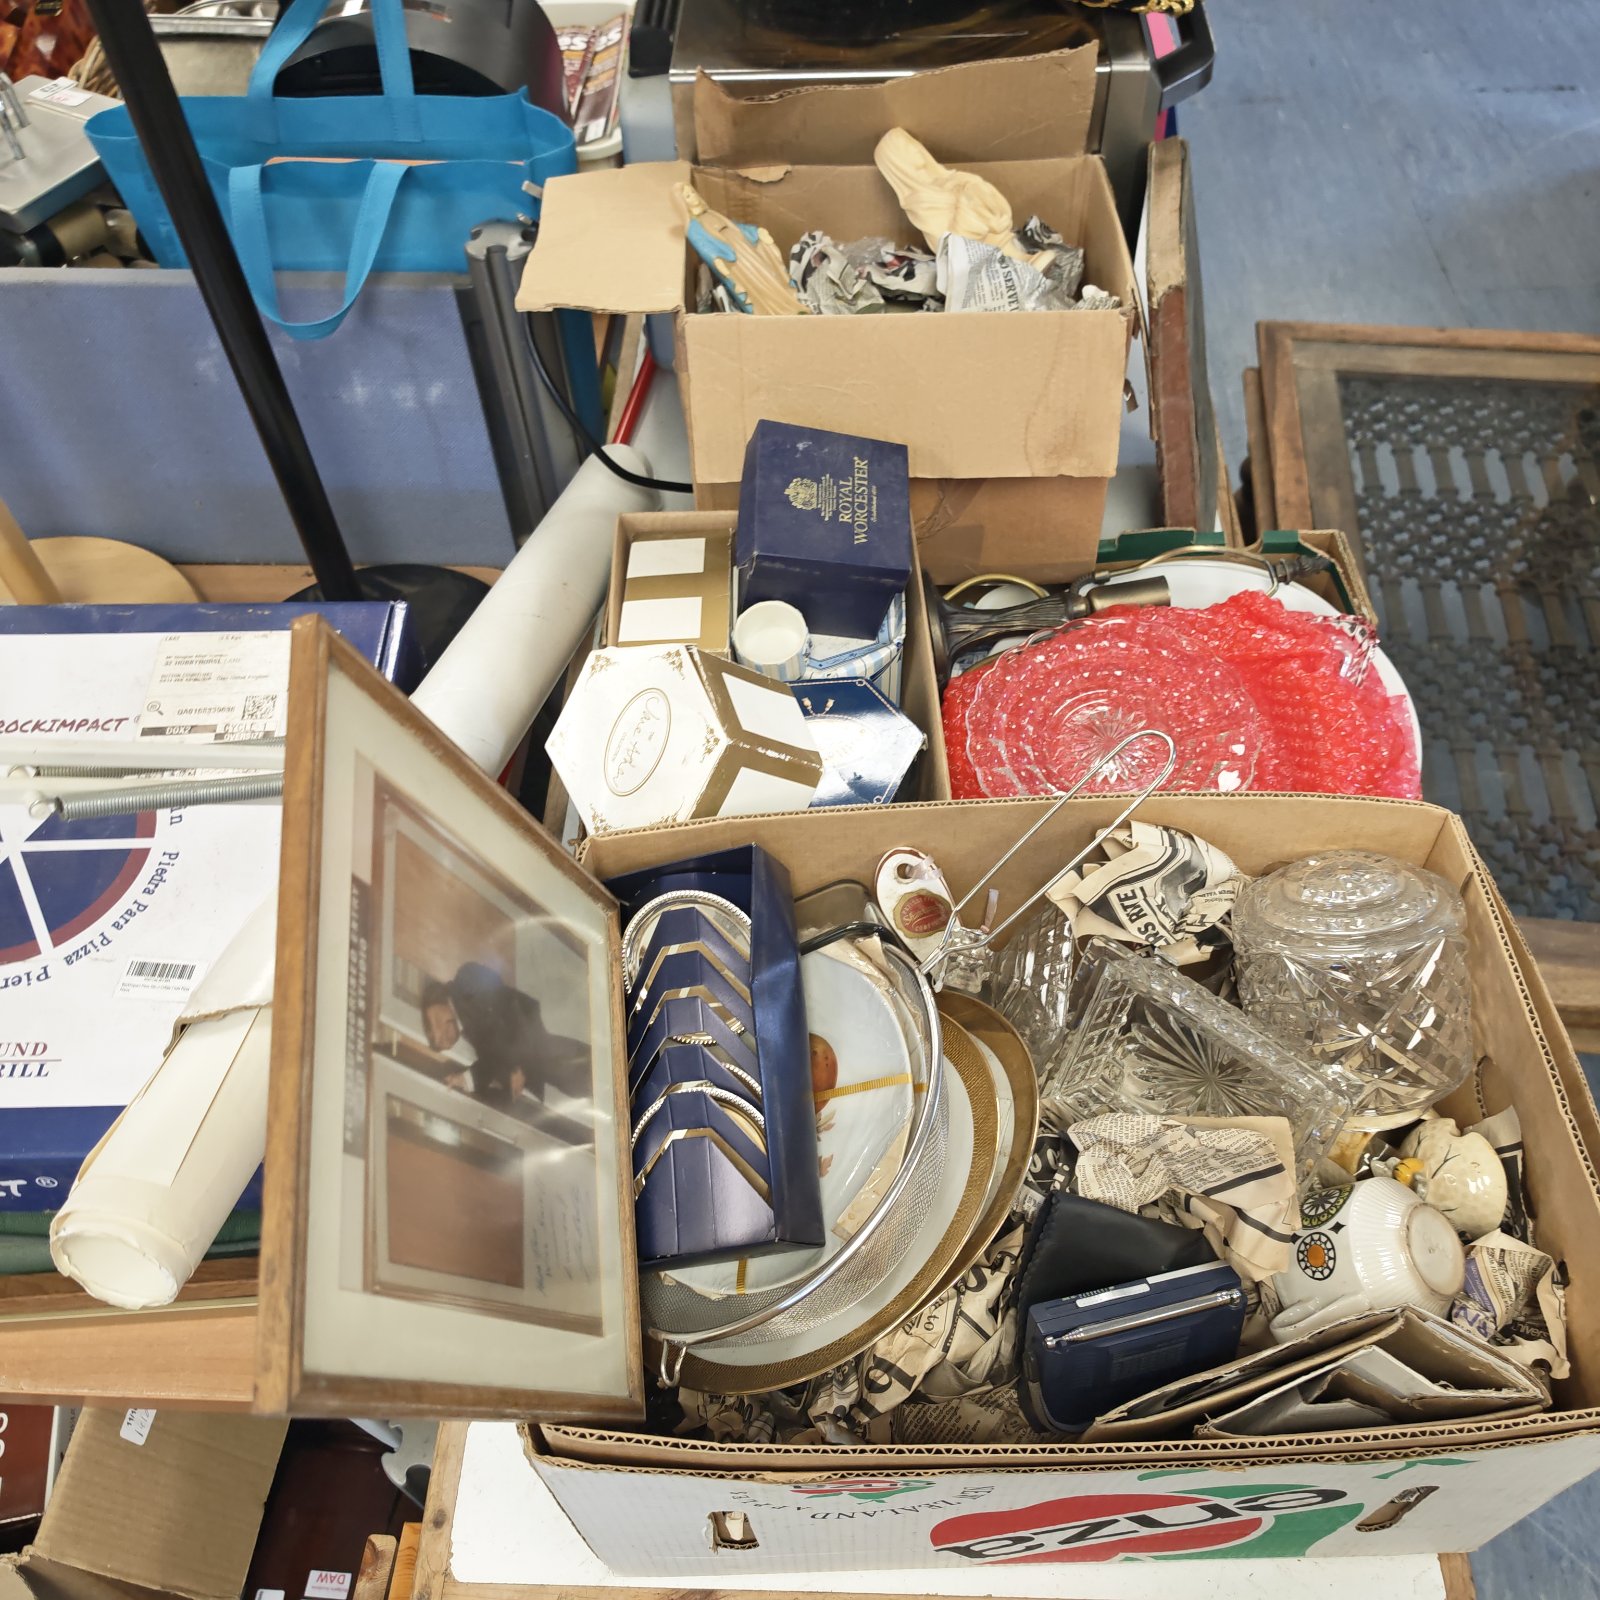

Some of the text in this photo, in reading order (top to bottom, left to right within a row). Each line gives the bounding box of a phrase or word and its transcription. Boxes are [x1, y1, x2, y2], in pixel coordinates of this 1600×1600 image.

[839, 476, 853, 523] ROYAL
[853, 458, 868, 545] WORCESTER
[63, 851, 180, 966] Piedra Para Pizza
[810, 1499, 961, 1520] ZEALAND
[935, 1489, 1348, 1559] enza
[316, 1573, 346, 1585] DAW
